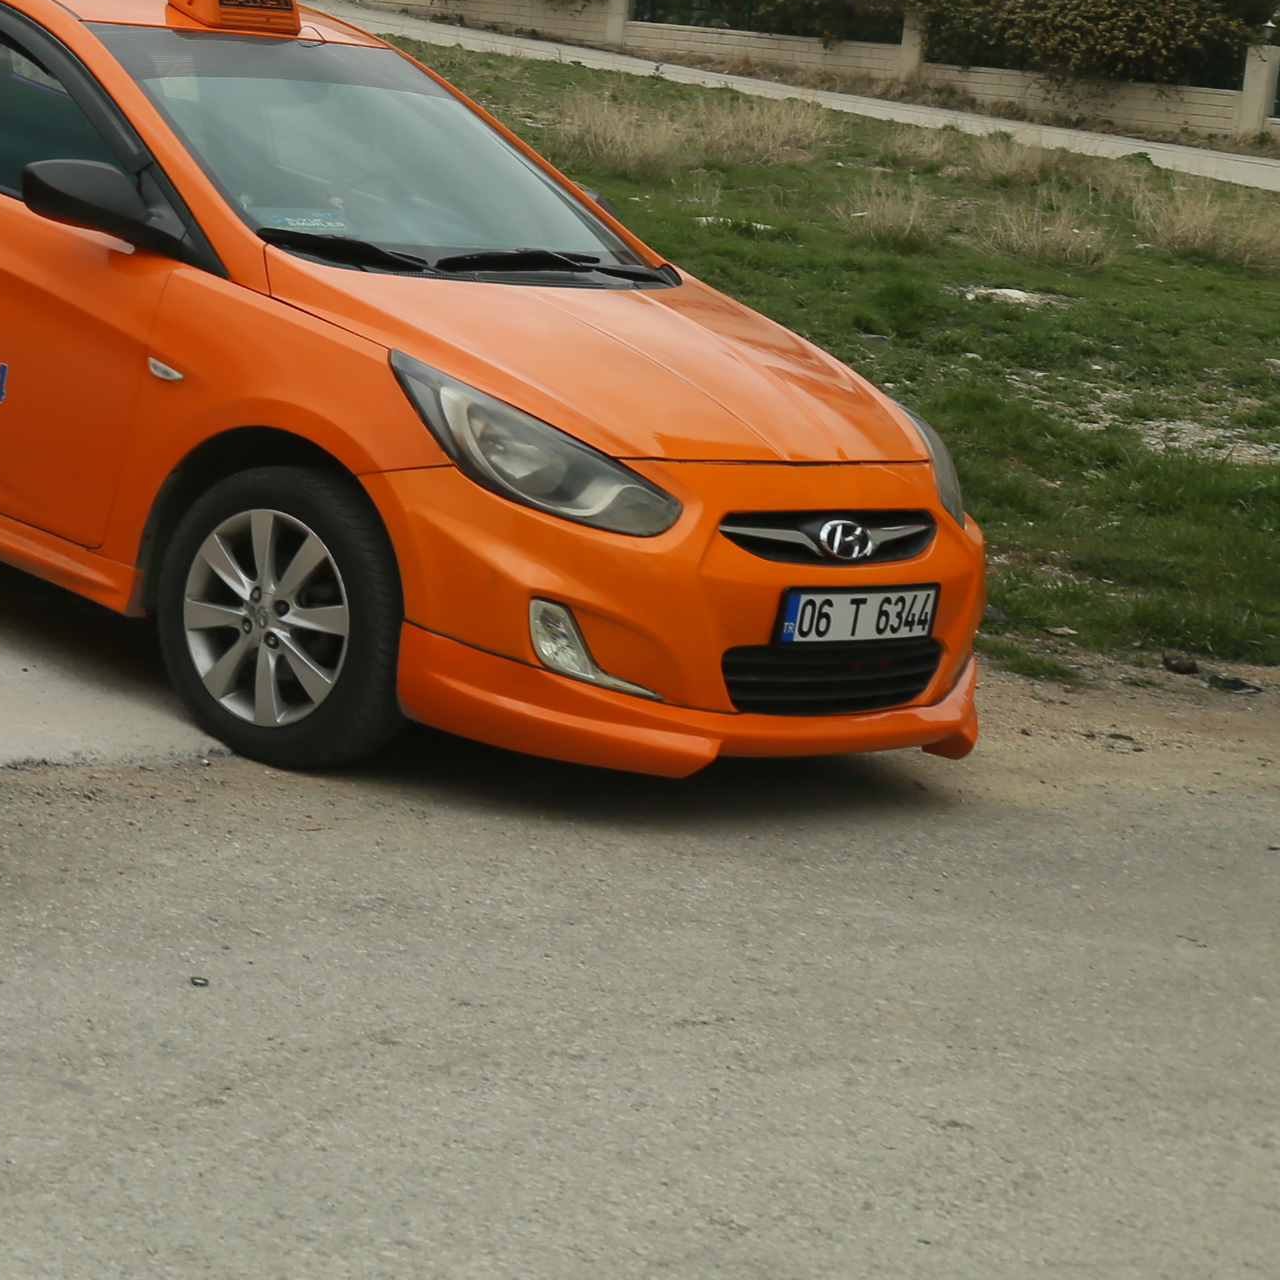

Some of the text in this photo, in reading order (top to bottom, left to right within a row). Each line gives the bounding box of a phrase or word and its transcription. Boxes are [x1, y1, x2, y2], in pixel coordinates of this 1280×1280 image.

[783, 622, 795, 634] TR
[797, 593, 932, 638] 06 T 6344
